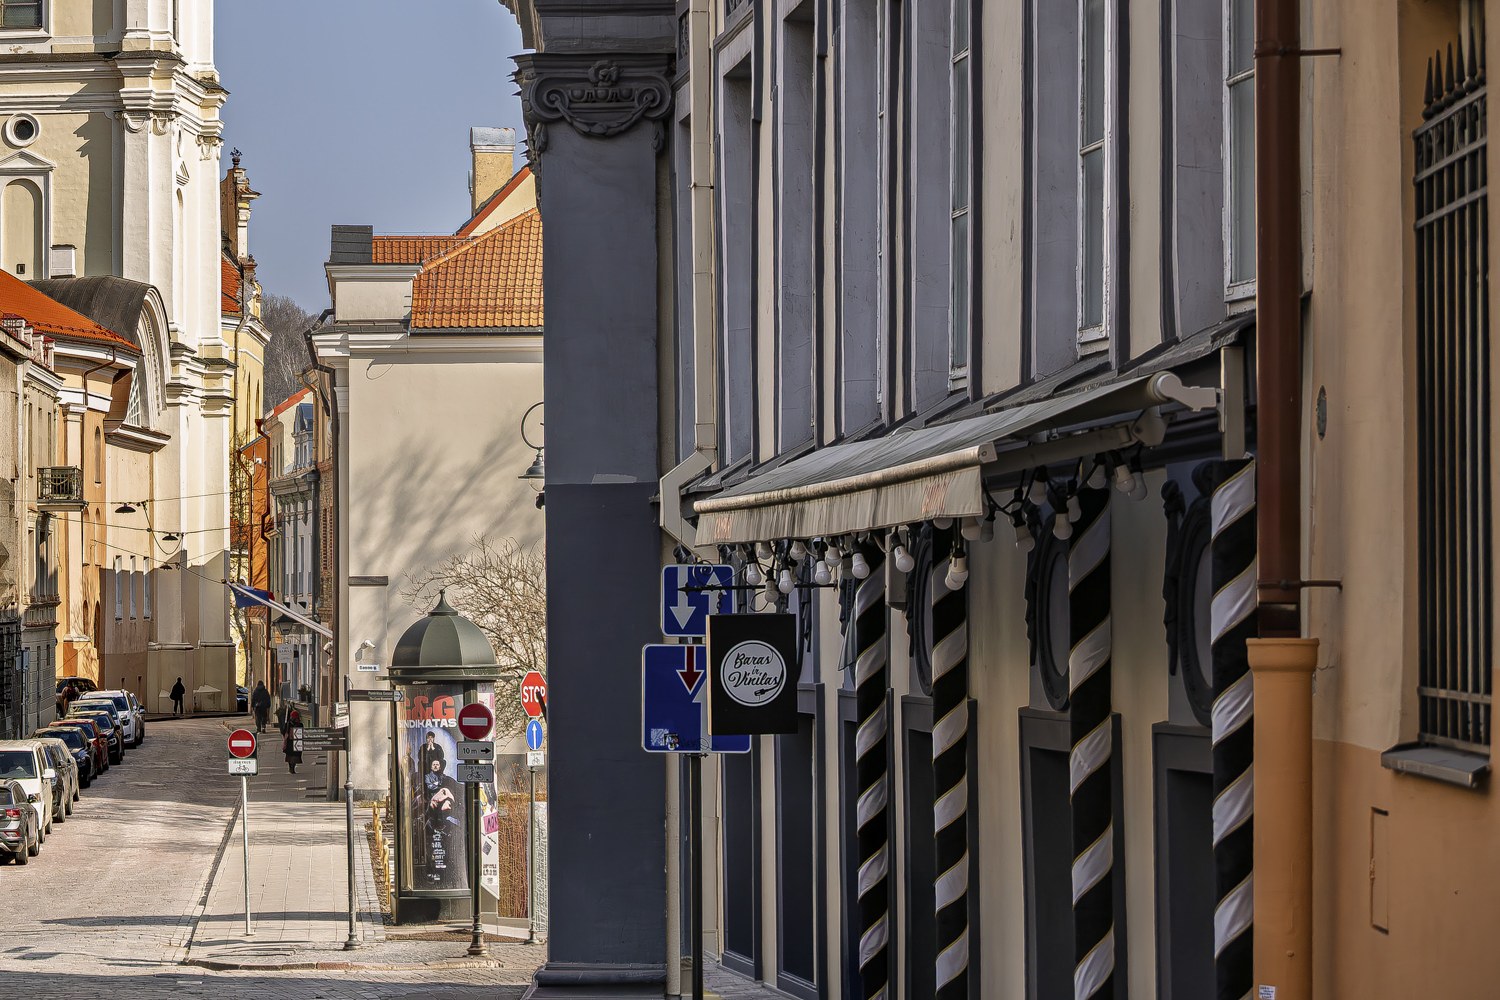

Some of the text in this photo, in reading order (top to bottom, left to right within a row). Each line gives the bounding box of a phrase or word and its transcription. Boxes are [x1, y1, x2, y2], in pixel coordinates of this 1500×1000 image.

[734, 652, 773, 669] Baras
[752, 666, 759, 675] ir
[728, 671, 778, 687] Vinilas
[522, 686, 546, 703] STOP
